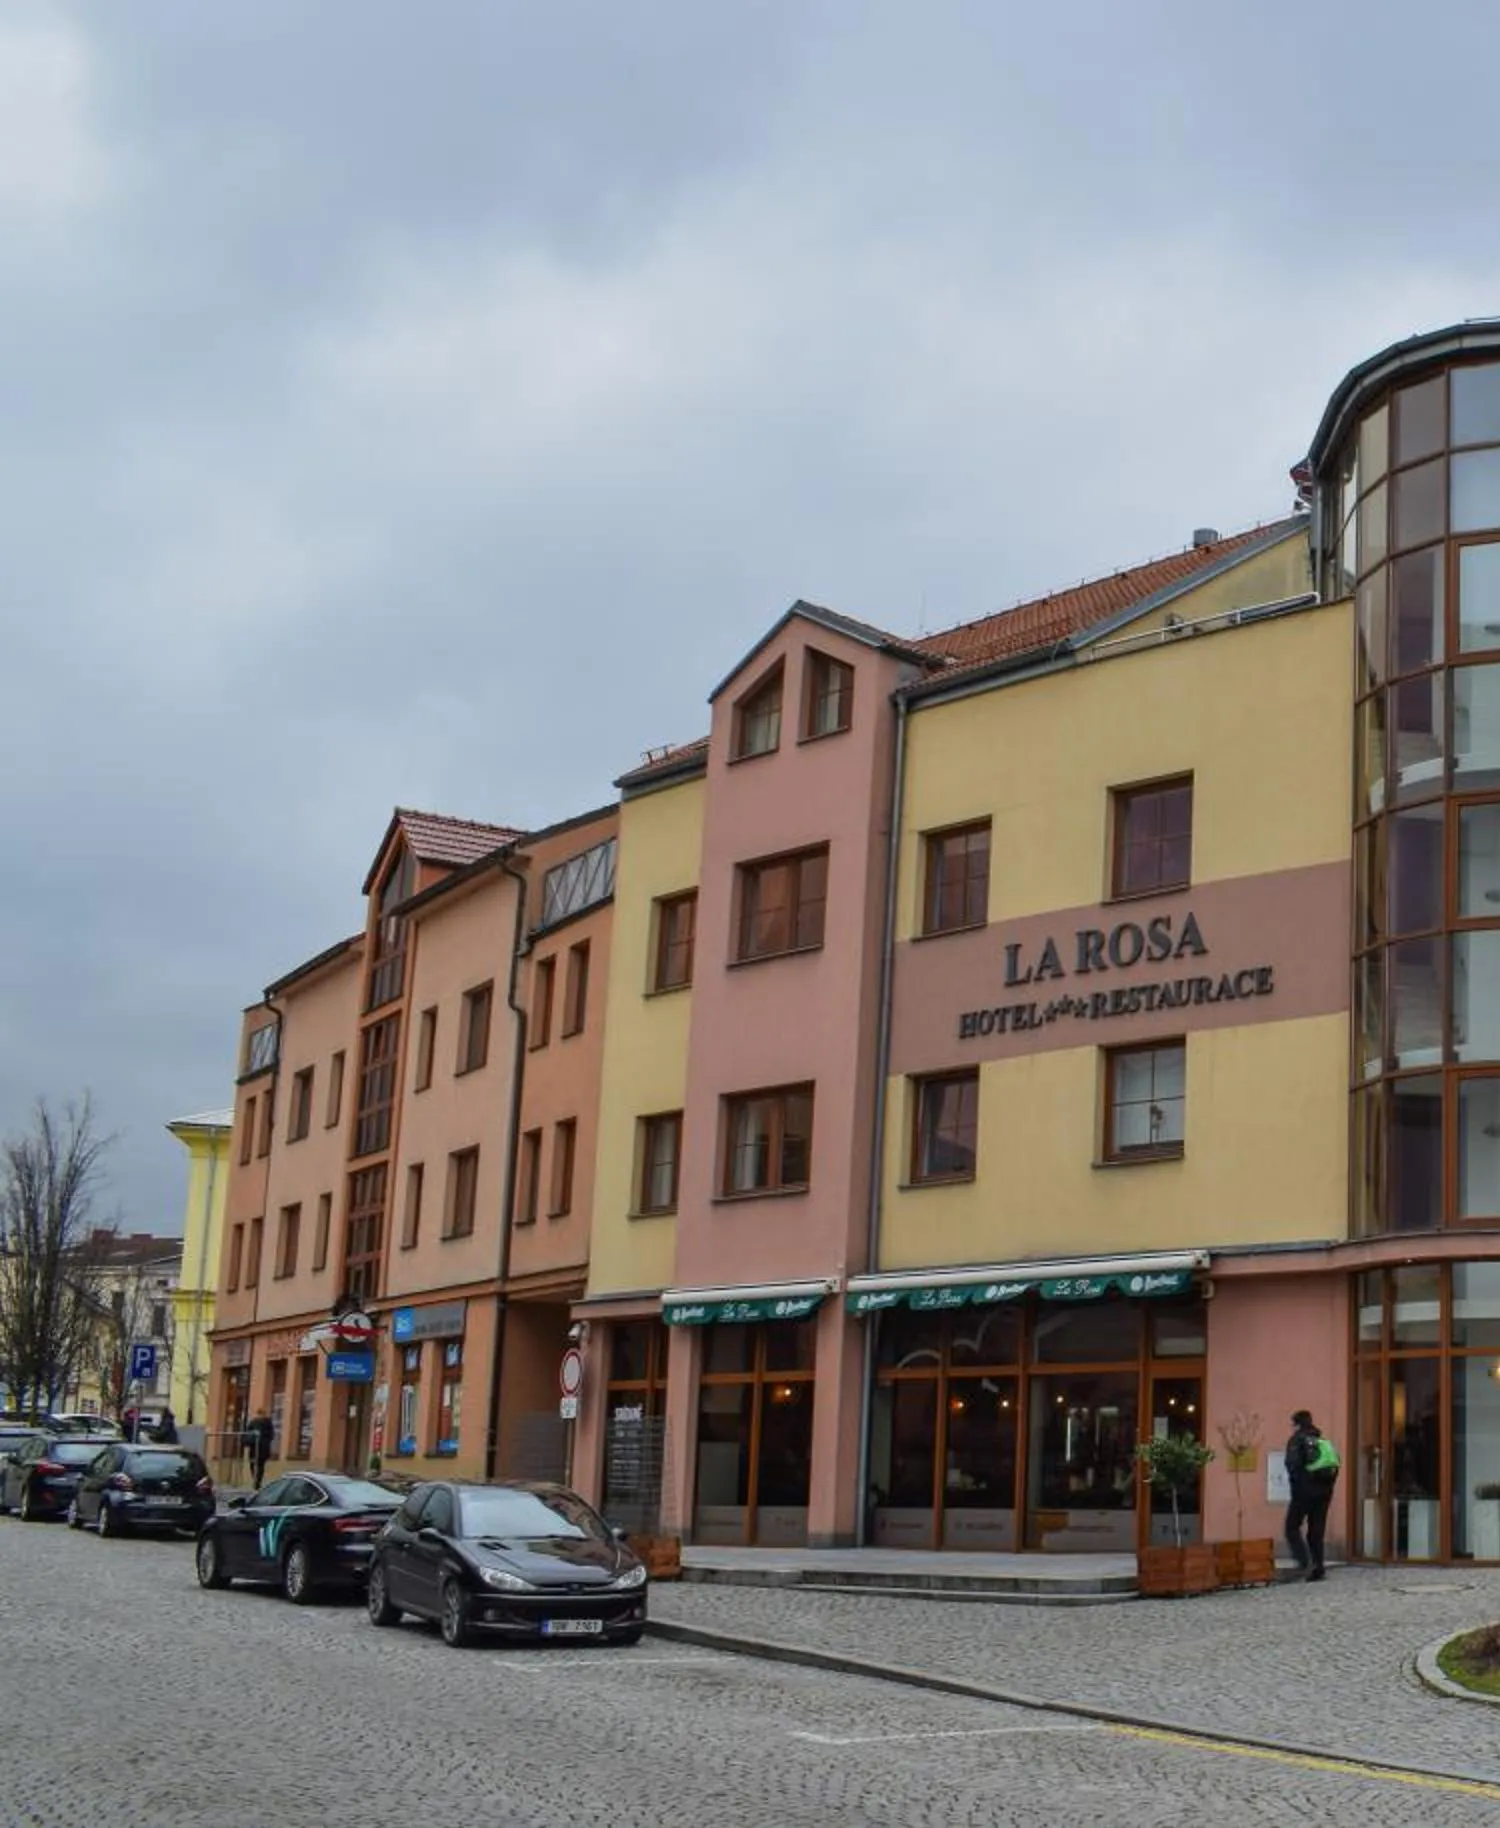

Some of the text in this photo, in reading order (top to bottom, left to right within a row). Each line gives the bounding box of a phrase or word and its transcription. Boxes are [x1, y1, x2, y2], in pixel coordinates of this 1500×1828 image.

[1004, 912, 1208, 987] LA ROSA
[959, 966, 1274, 1039] HOTEL RESTAURACE
[135, 1347, 151, 1368] P
